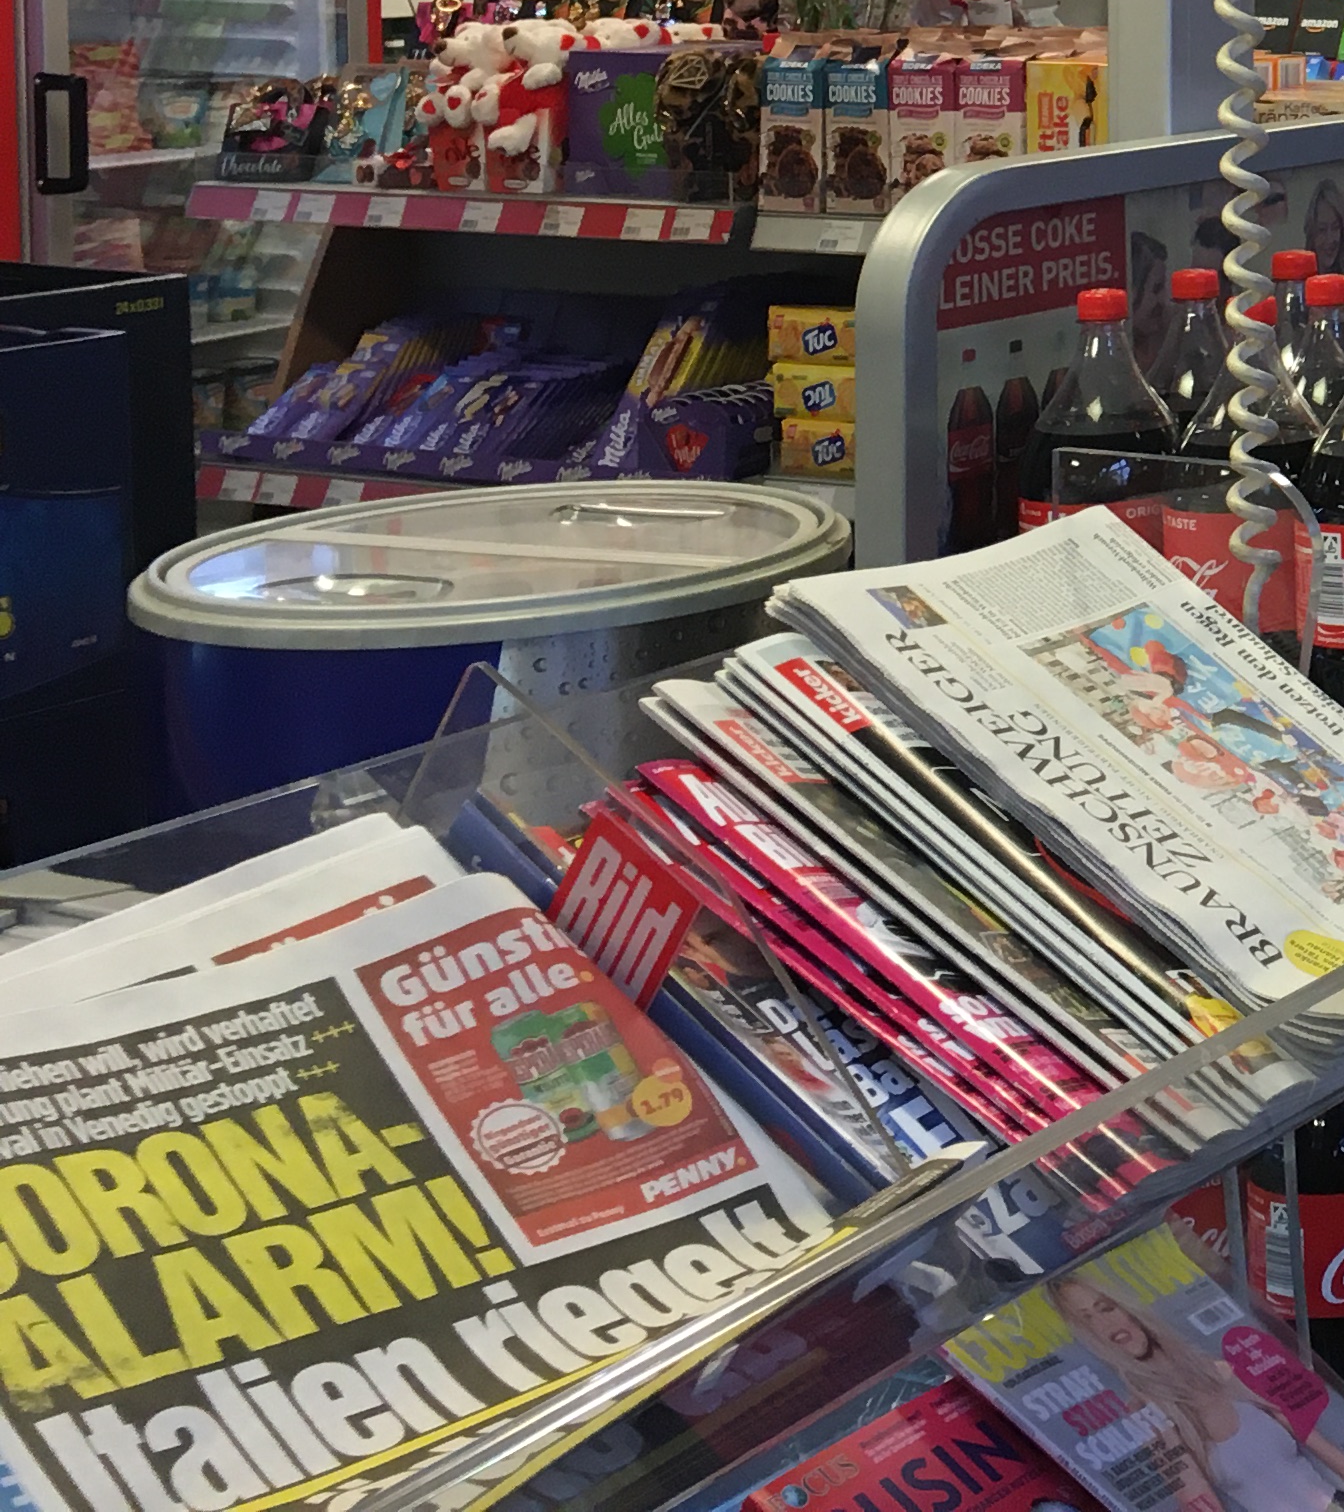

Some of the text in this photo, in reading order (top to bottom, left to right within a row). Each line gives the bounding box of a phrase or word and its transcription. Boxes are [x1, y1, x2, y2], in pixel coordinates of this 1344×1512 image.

[1300, 17, 1339, 31] amazon
[766, 84, 813, 103] COOKIES
[829, 84, 876, 104] COOKIES
[892, 86, 943, 105] COOKIES
[959, 86, 1010, 106] COOKIES
[608, 103, 651, 134] Alles
[221, 157, 284, 177] Chocolate
[1030, 211, 1098, 246] COKE
[1041, 252, 1120, 294] PREIS.
[803, 326, 837, 352] TUC
[599, 410, 633, 469] Milka
[813, 435, 843, 463] TUC
[1177, 597, 1238, 650] Regen
[1232, 642, 1279, 684] dem
[883, 627, 1286, 970] BRAUNSCHWEIGER
[1007, 708, 1213, 867] ZEITUNG
[201, 994, 323, 1046] verhaftet
[402, 999, 476, 1047] für
[67, 1099, 182, 1143] Venedig
[181, 1068, 299, 1123] gestoppt
[641, 1088, 684, 1116] 1.79
[0, 1091, 425, 1287] ORONA-
[0, 1177, 515, 1404] ALARM!
[1019, 1361, 1107, 1426] STRAFF
[1060, 1383, 1133, 1442] STATT
[34, 1329, 482, 1512] Italien
[766, 1454, 860, 1512] FOCUS
